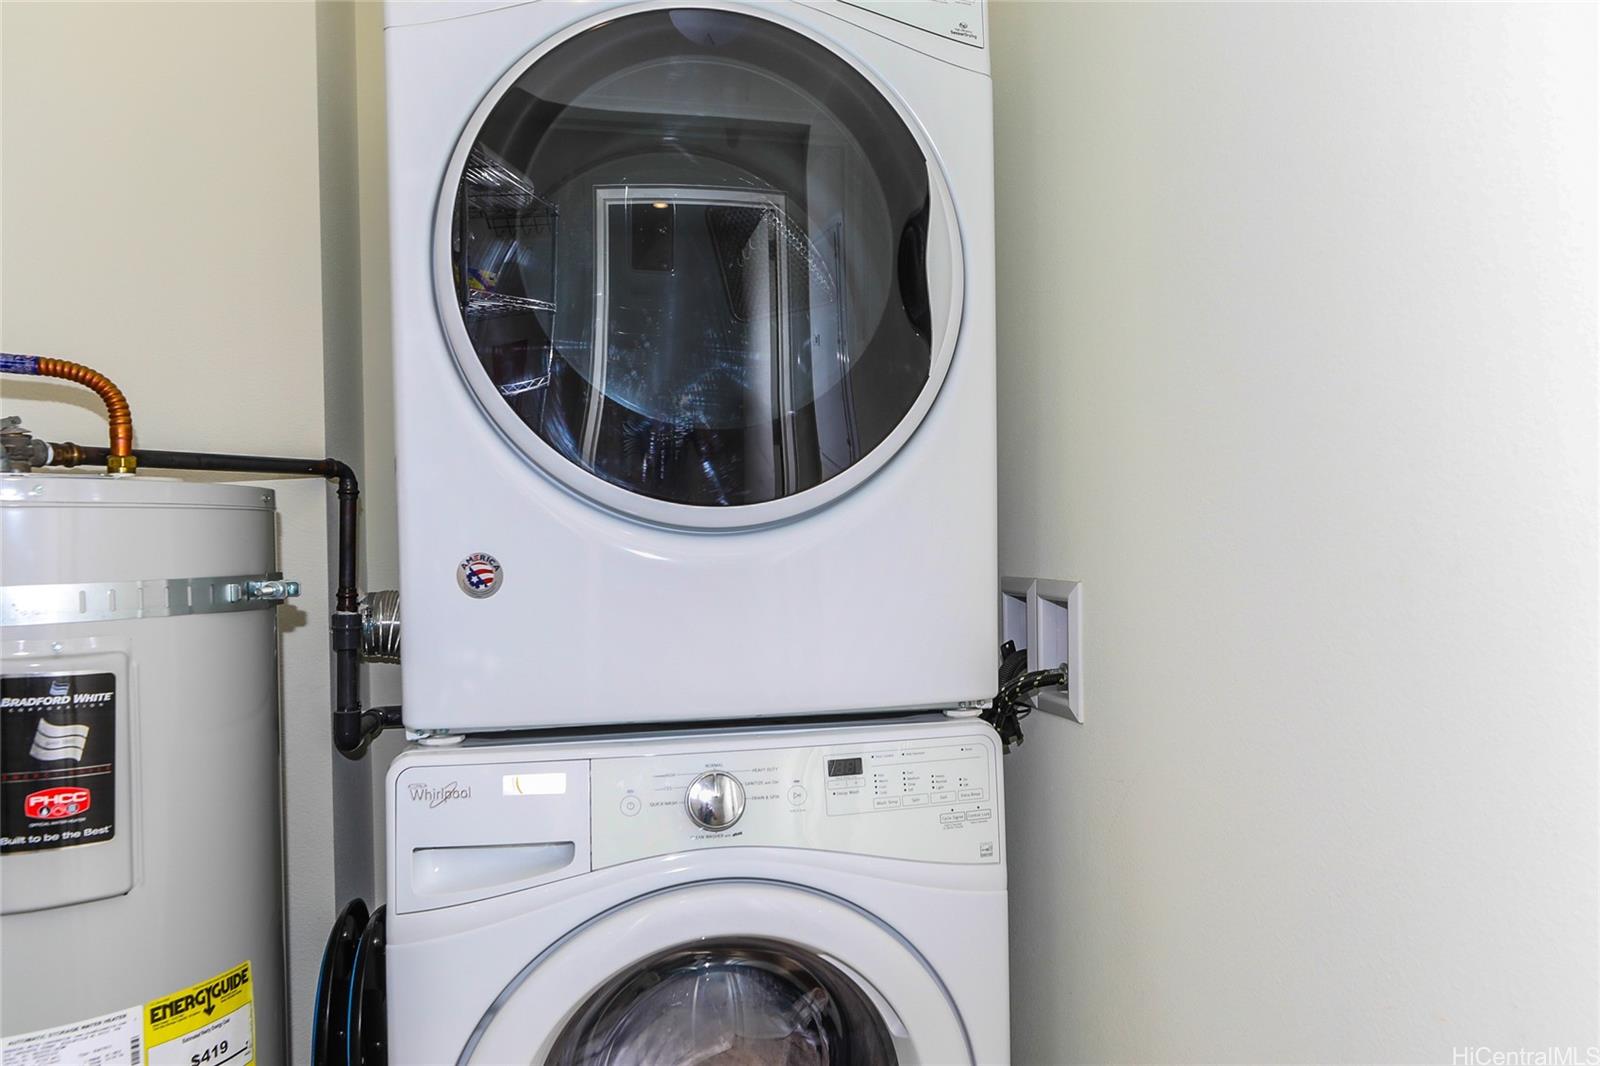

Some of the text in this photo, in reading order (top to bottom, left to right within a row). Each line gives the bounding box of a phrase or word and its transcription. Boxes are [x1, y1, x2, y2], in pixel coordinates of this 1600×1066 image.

[461, 554, 501, 572] AMERICA
[0, 692, 113, 708] BRADFORD WHITE
[29, 792, 88, 807] PHCC
[409, 786, 471, 804] Whirlpool
[0, 826, 111, 846] Built to be the Best
